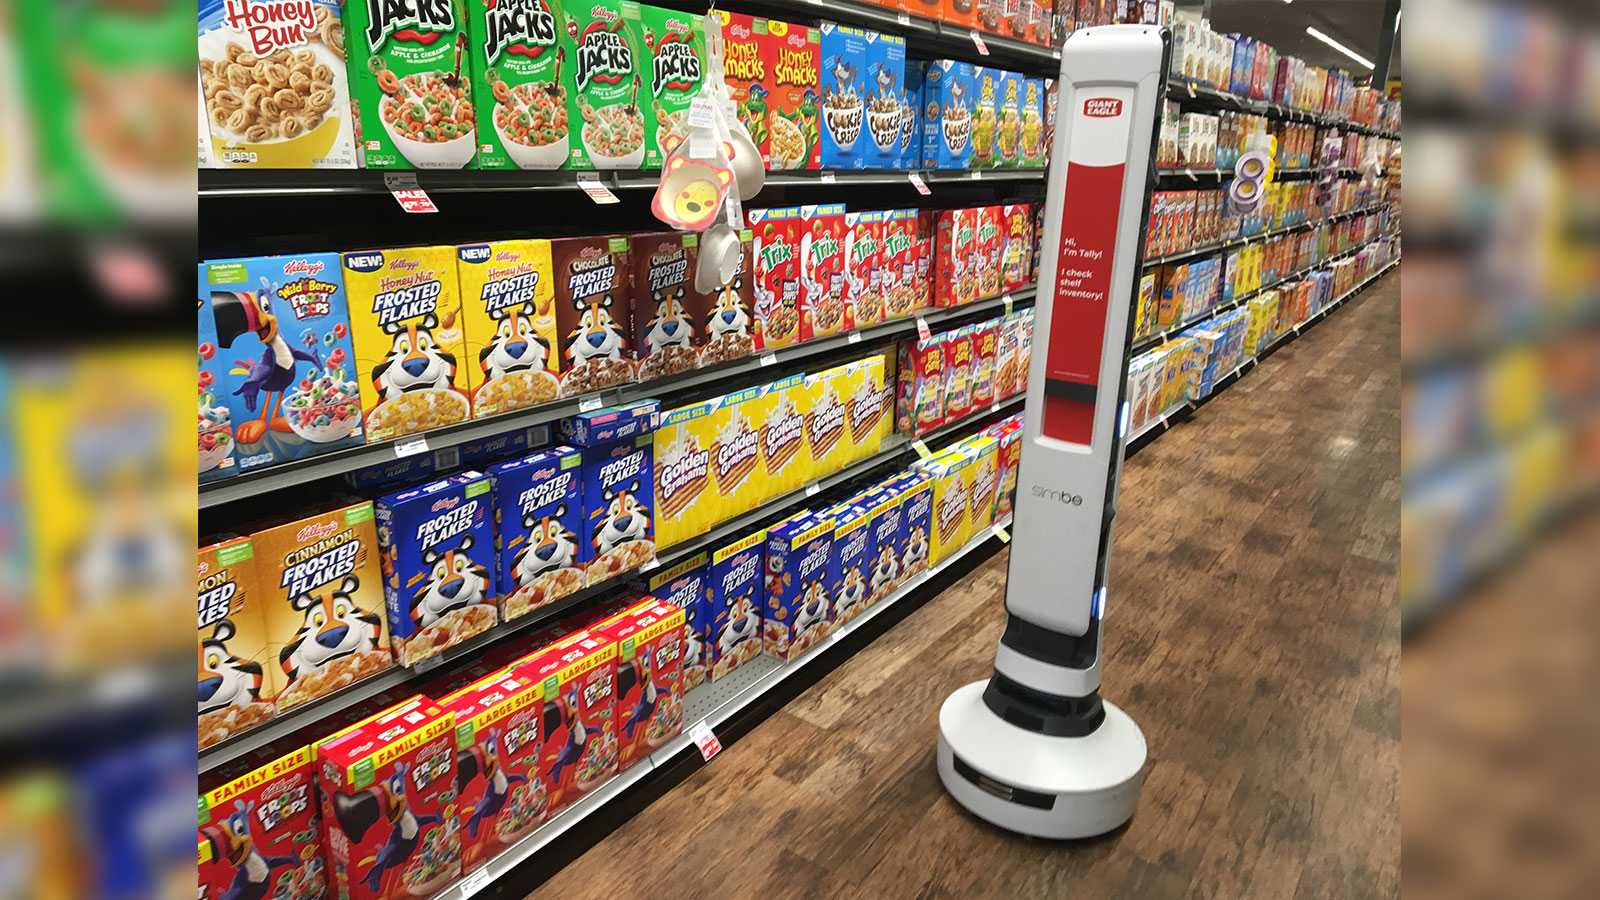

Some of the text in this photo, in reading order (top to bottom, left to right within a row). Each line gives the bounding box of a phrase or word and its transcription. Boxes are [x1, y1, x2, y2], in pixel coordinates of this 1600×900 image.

[227, 0, 314, 29] Honey
[369, 0, 451, 45] JACKS
[248, 24, 304, 55] Bun
[487, 8, 553, 58] JACKS
[586, 33, 619, 48] APPLE
[661, 44, 689, 58] APPLE
[779, 48, 812, 67] HONEY
[578, 45, 630, 86] JACKS
[653, 55, 698, 92] JACKS
[723, 58, 764, 79] MACKS
[775, 63, 817, 85] SMACKS
[1087, 107, 1118, 115] EAGLE
[1088, 100, 1119, 108] GIANT
[461, 247, 490, 259] NEW!
[761, 237, 791, 271] Trix
[811, 233, 837, 263] Trix
[854, 234, 876, 263] Trix
[886, 230, 909, 256] Trix
[1063, 248, 1103, 260] I'm Tally!
[1065, 238, 1076, 247] Hi,
[284, 260, 324, 275] Kellogg's
[348, 257, 382, 268] NEW!
[390, 259, 419, 270] Kellogg's
[572, 255, 609, 272] CHOCOLATE
[649, 260, 687, 281] FROSTED
[652, 249, 682, 265] CHOCOLATE
[381, 271, 433, 291] Honey Nut
[481, 272, 538, 300] FROSTED
[488, 266, 516, 281] Honey
[569, 266, 614, 289] FROSTED
[651, 271, 685, 291] FLAKES
[1060, 278, 1082, 287] shelf
[1066, 268, 1092, 279] check
[278, 279, 337, 298] Wild Berry
[291, 292, 328, 308] FROOT
[374, 281, 440, 312] FROSTED
[486, 288, 535, 312] FLAKES
[573, 281, 612, 300] FLAKES
[1059, 287, 1103, 301] inventory!
[296, 303, 328, 318] LOOPS
[380, 297, 436, 325] FLAKES
[813, 403, 845, 431] Golden
[854, 391, 882, 417] Golden
[767, 415, 803, 444] Golden
[768, 428, 802, 457] Grahams
[815, 417, 844, 443] Grahams
[718, 431, 758, 464] Golden
[720, 444, 756, 476] Grahams
[599, 450, 643, 480] FROSTED
[602, 462, 640, 489] FLAKES
[661, 450, 709, 487] Golden
[518, 472, 571, 505] FROSTED
[664, 464, 707, 499] Grahams
[522, 485, 566, 516] FLAKES
[1032, 485, 1083, 506] simbe
[296, 520, 338, 542] Kellogg's
[416, 500, 478, 540] FROSTED
[421, 514, 473, 551] FLAKES
[286, 529, 353, 566] CINNAMON
[721, 541, 744, 557] FAMILY
[745, 535, 758, 547] SIZE
[799, 540, 831, 571] FROSTED
[282, 540, 359, 586] FROSTED
[721, 554, 758, 587] FROSTED
[800, 552, 827, 579] FLAKES
[289, 556, 354, 598] FLAKES
[724, 566, 755, 595] FLAKES
[563, 650, 612, 680] LARGE SIZE
[479, 689, 537, 725] LARGE SIZE
[378, 734, 422, 763] FAMILY
[426, 719, 450, 738] SIZE
[214, 753, 304, 802] FAMILY SIZE
